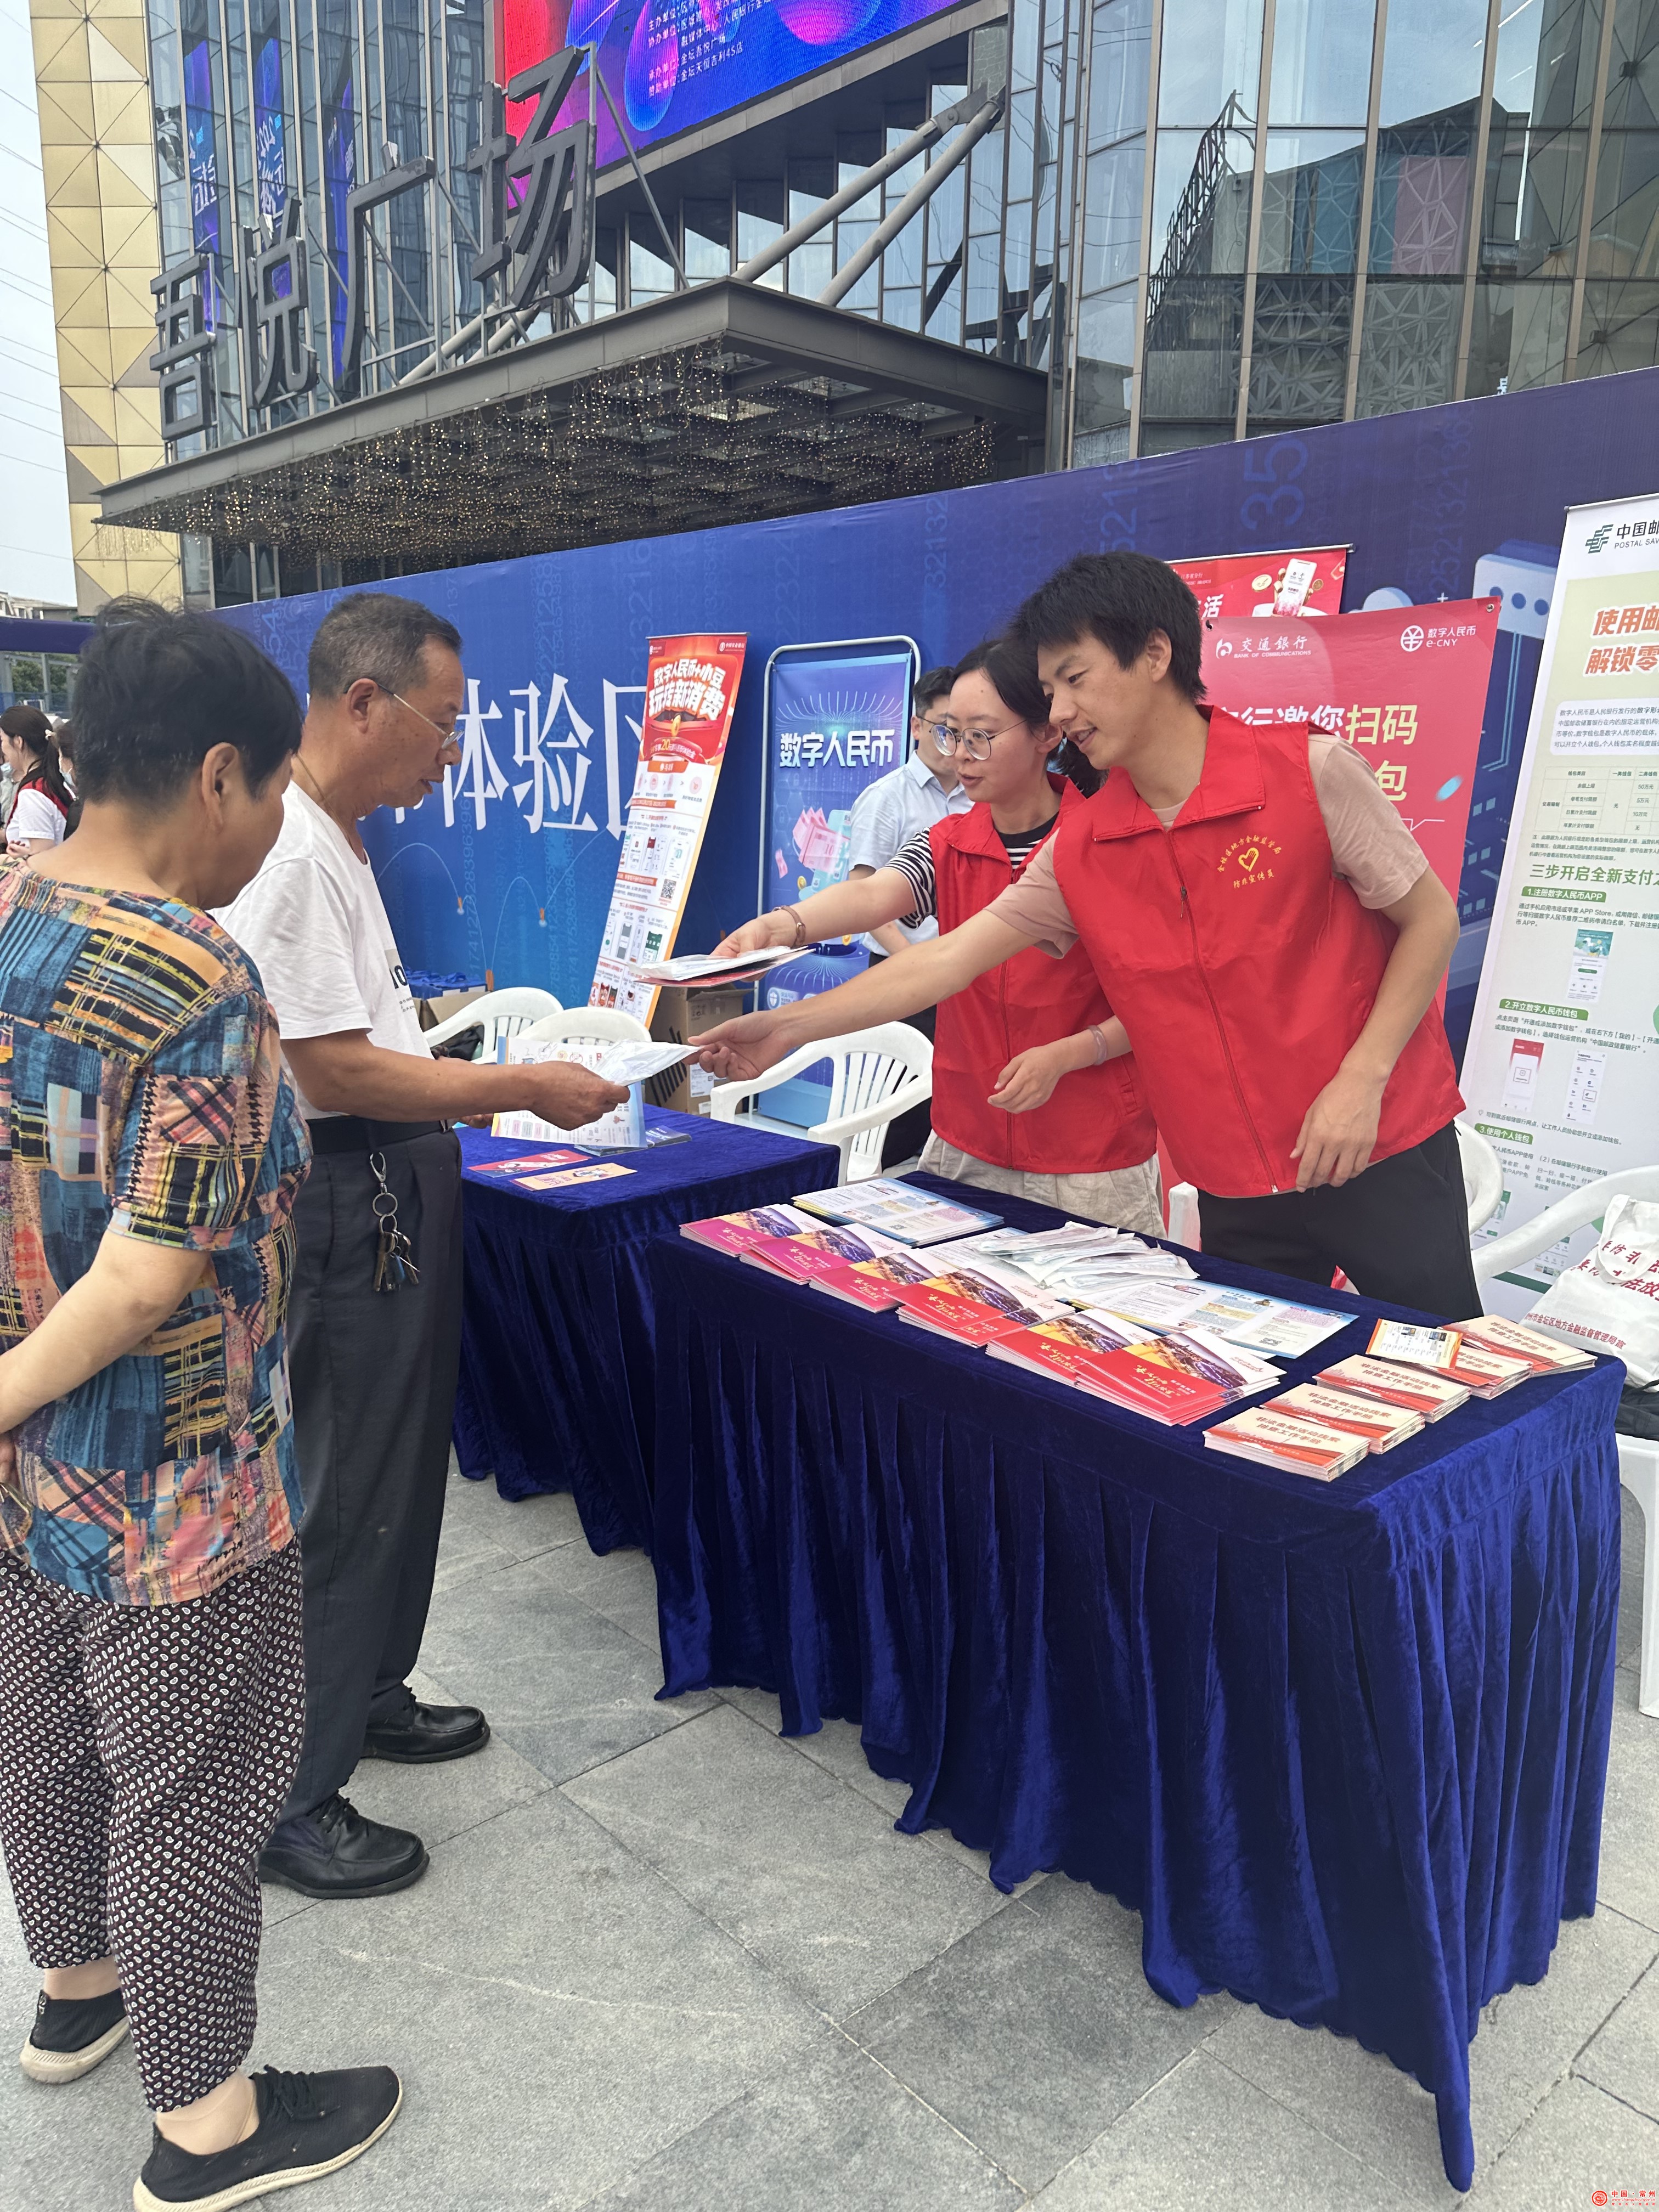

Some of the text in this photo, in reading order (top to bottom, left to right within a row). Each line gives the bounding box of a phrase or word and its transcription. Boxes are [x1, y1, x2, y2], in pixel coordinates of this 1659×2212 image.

[150, 45, 595, 440] 吾悦广场
[1614, 539, 1643, 549] POSTAL
[1198, 594, 1224, 620] 活
[1426, 638, 1458, 648] e-CNY
[1427, 625, 1477, 639] 数字人民币
[648, 678, 726, 721] 玩转新消费
[779, 729, 895, 768] 数字人民币
[1527, 888, 1603, 901] 1.注册数字人民币APP
[1504, 1000, 1578, 1019] 2.开立数字人民币钱包
[1256, 1416, 1341, 1443] 非法金融活动线索
